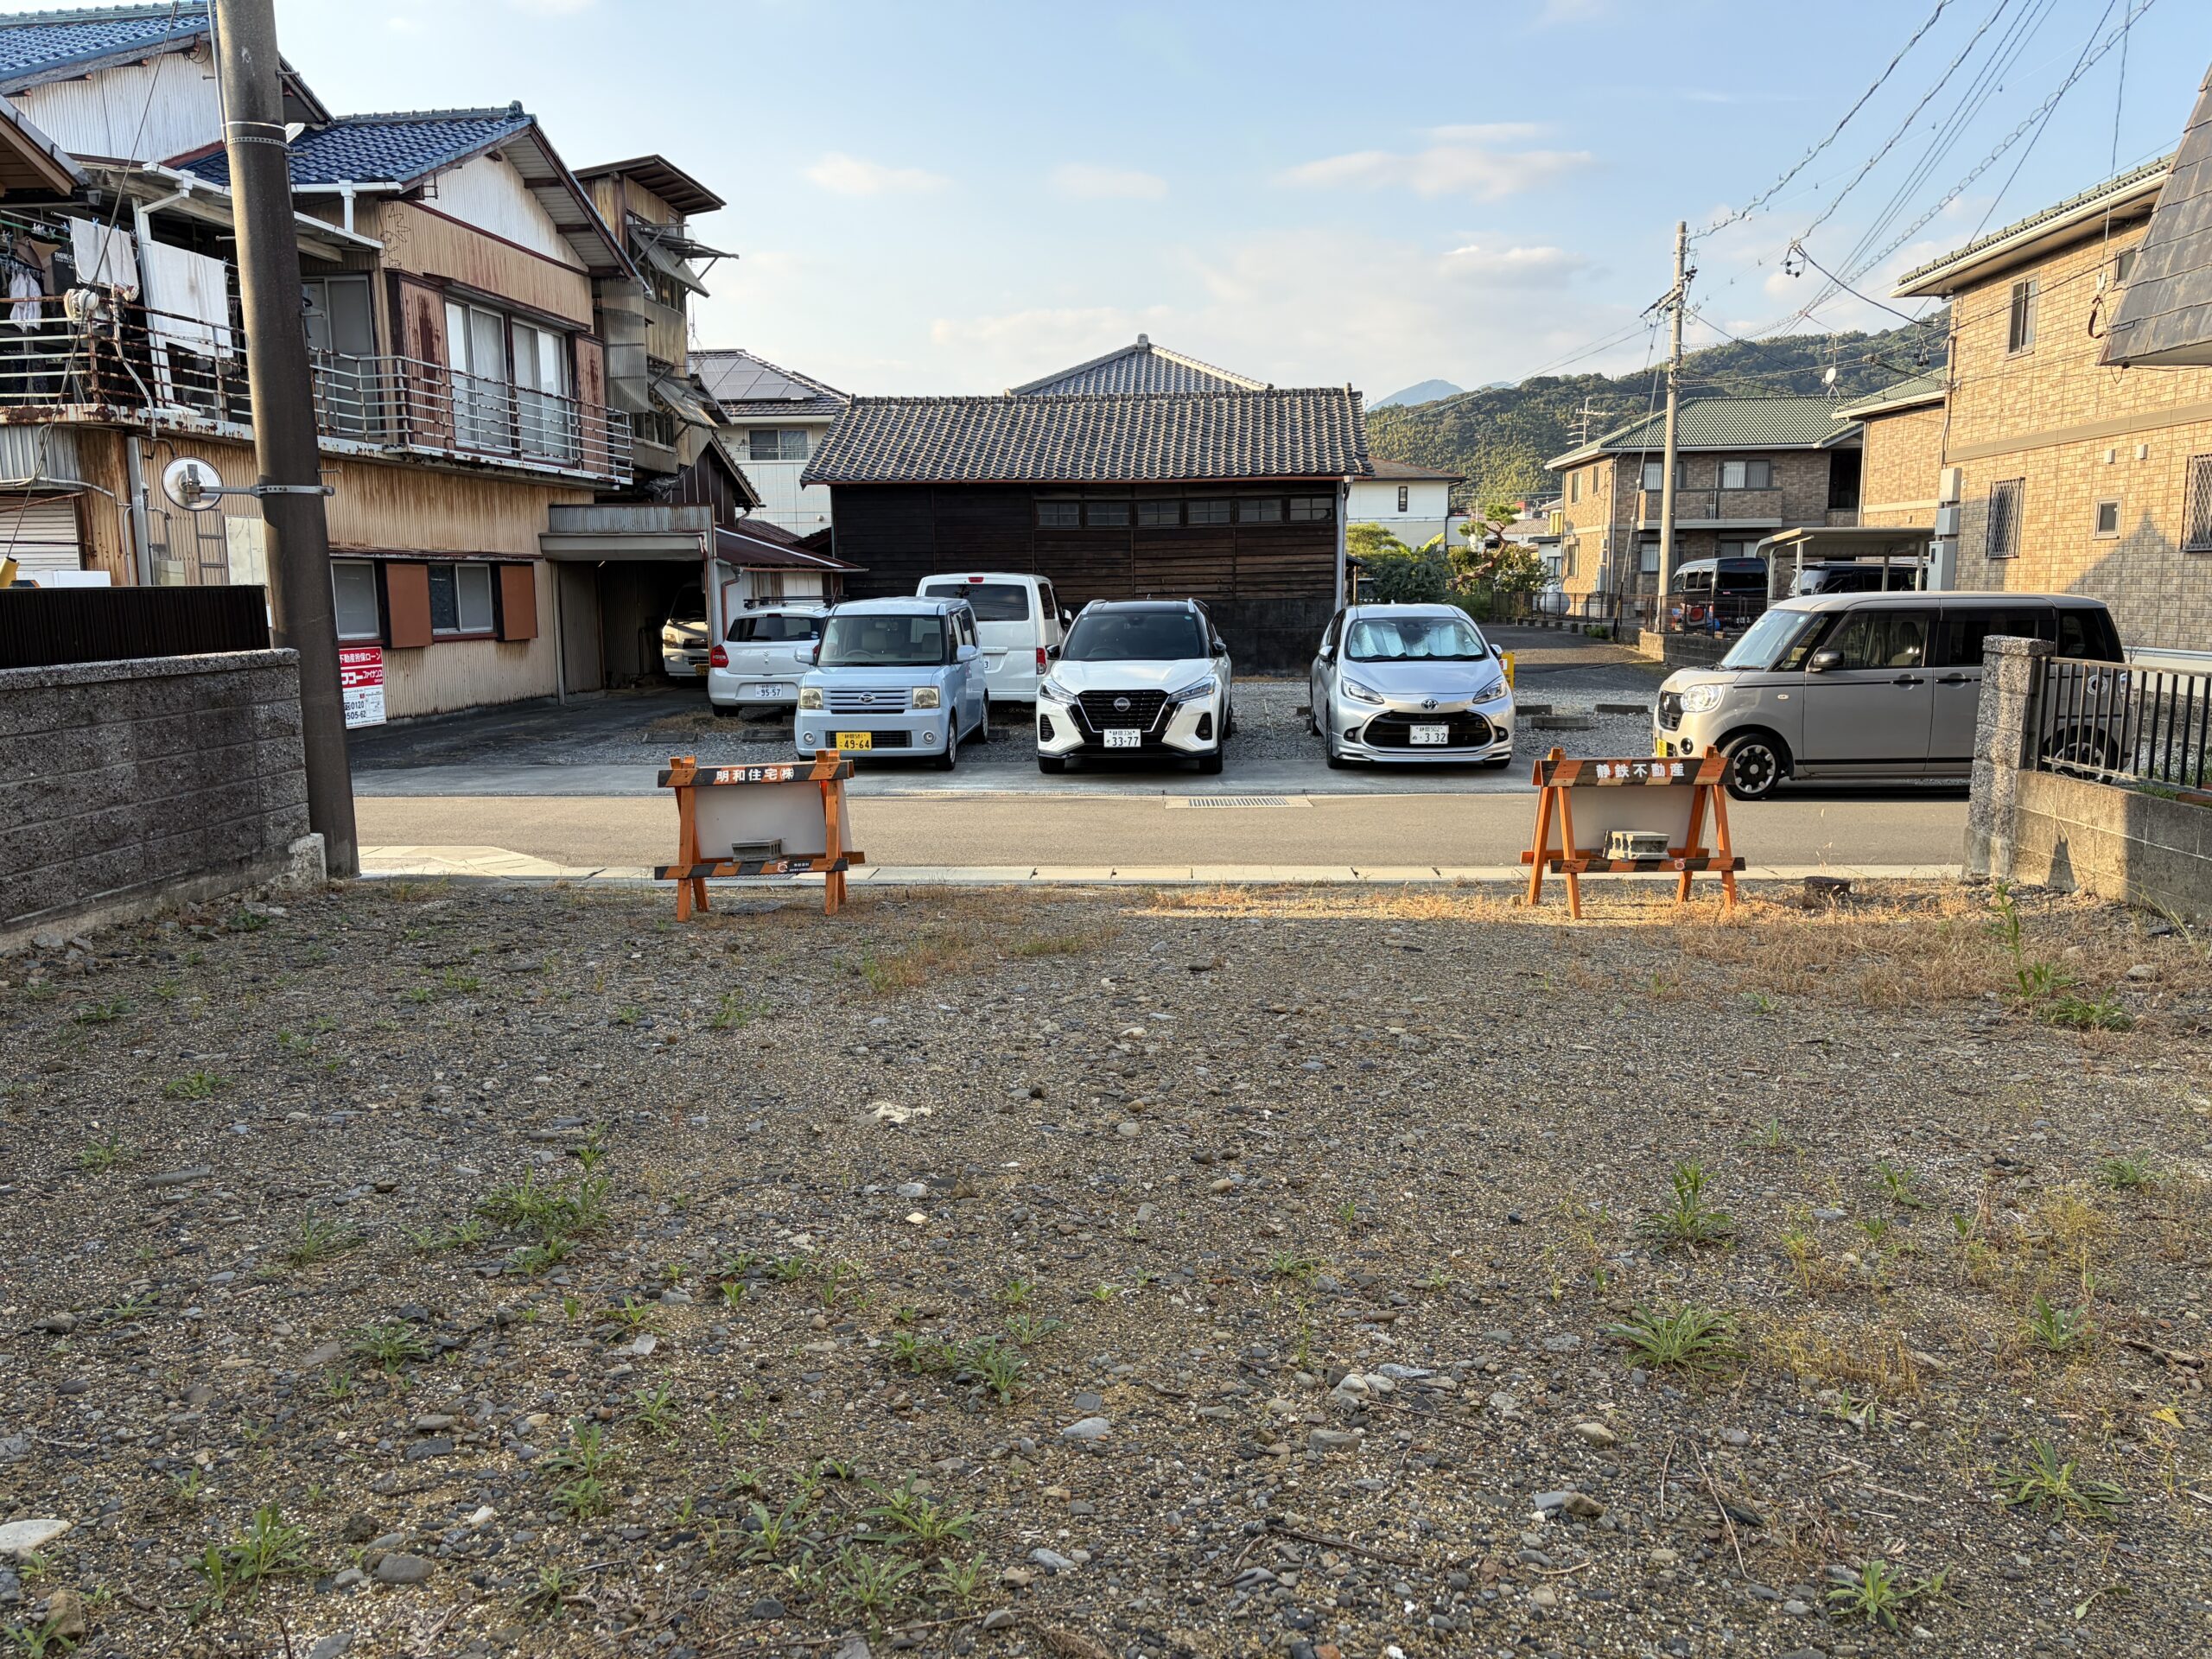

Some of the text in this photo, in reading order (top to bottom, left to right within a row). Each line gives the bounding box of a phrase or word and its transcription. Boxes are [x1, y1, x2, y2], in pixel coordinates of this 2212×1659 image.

[351, 701, 365, 710] 0120
[843, 739, 870, 749] 49-64
[1112, 736, 1139, 747] 33-77
[1596, 763, 1685, 779] 静鉄不動産
